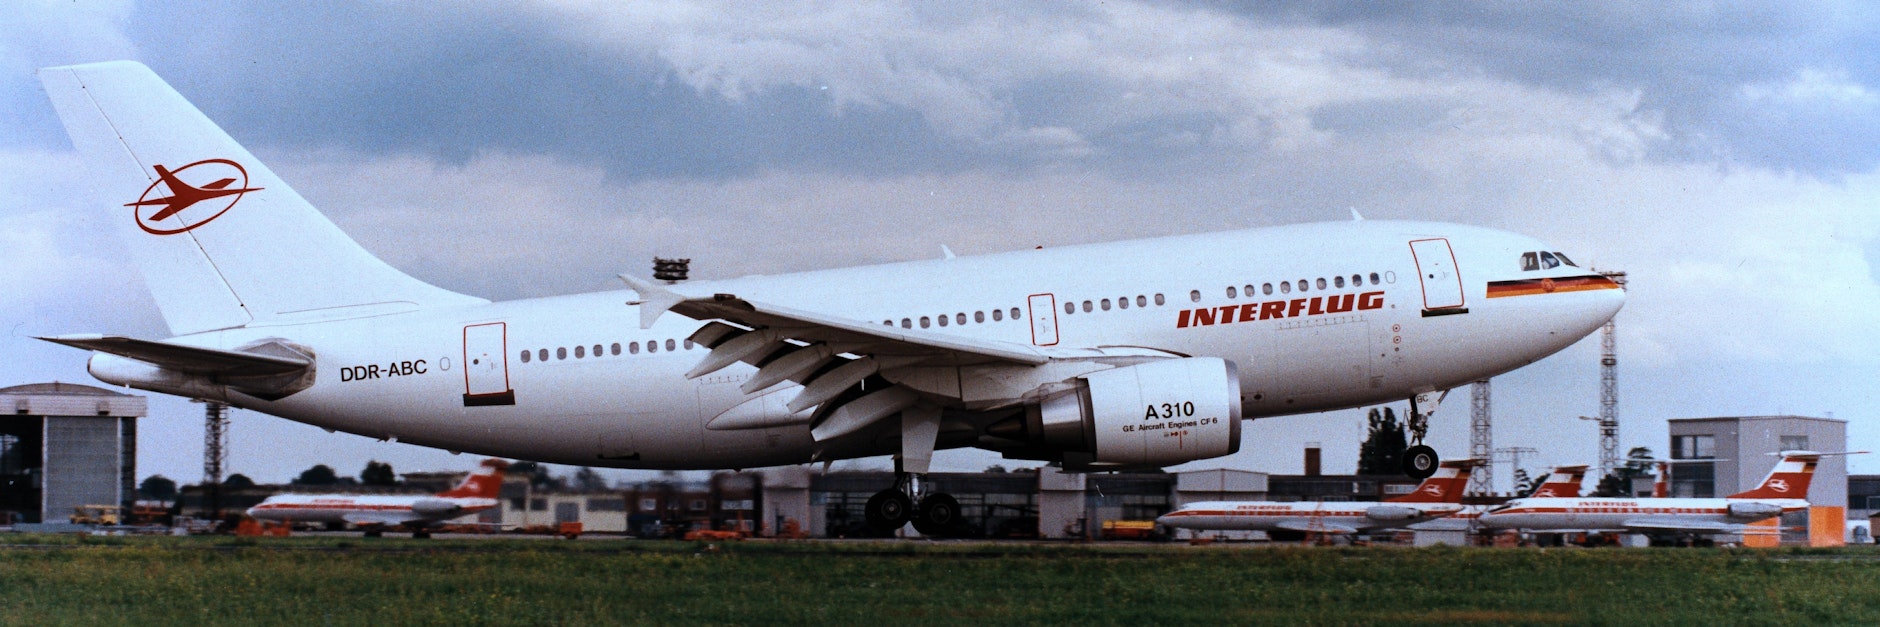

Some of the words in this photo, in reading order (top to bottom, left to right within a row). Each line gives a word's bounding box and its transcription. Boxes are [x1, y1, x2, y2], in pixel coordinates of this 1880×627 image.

[1177, 291, 1385, 328] INTERFLUG
[341, 359, 427, 382] DDR-ABC
[1138, 423, 1165, 431] Aircraft
[1168, 420, 1197, 429] Engines
